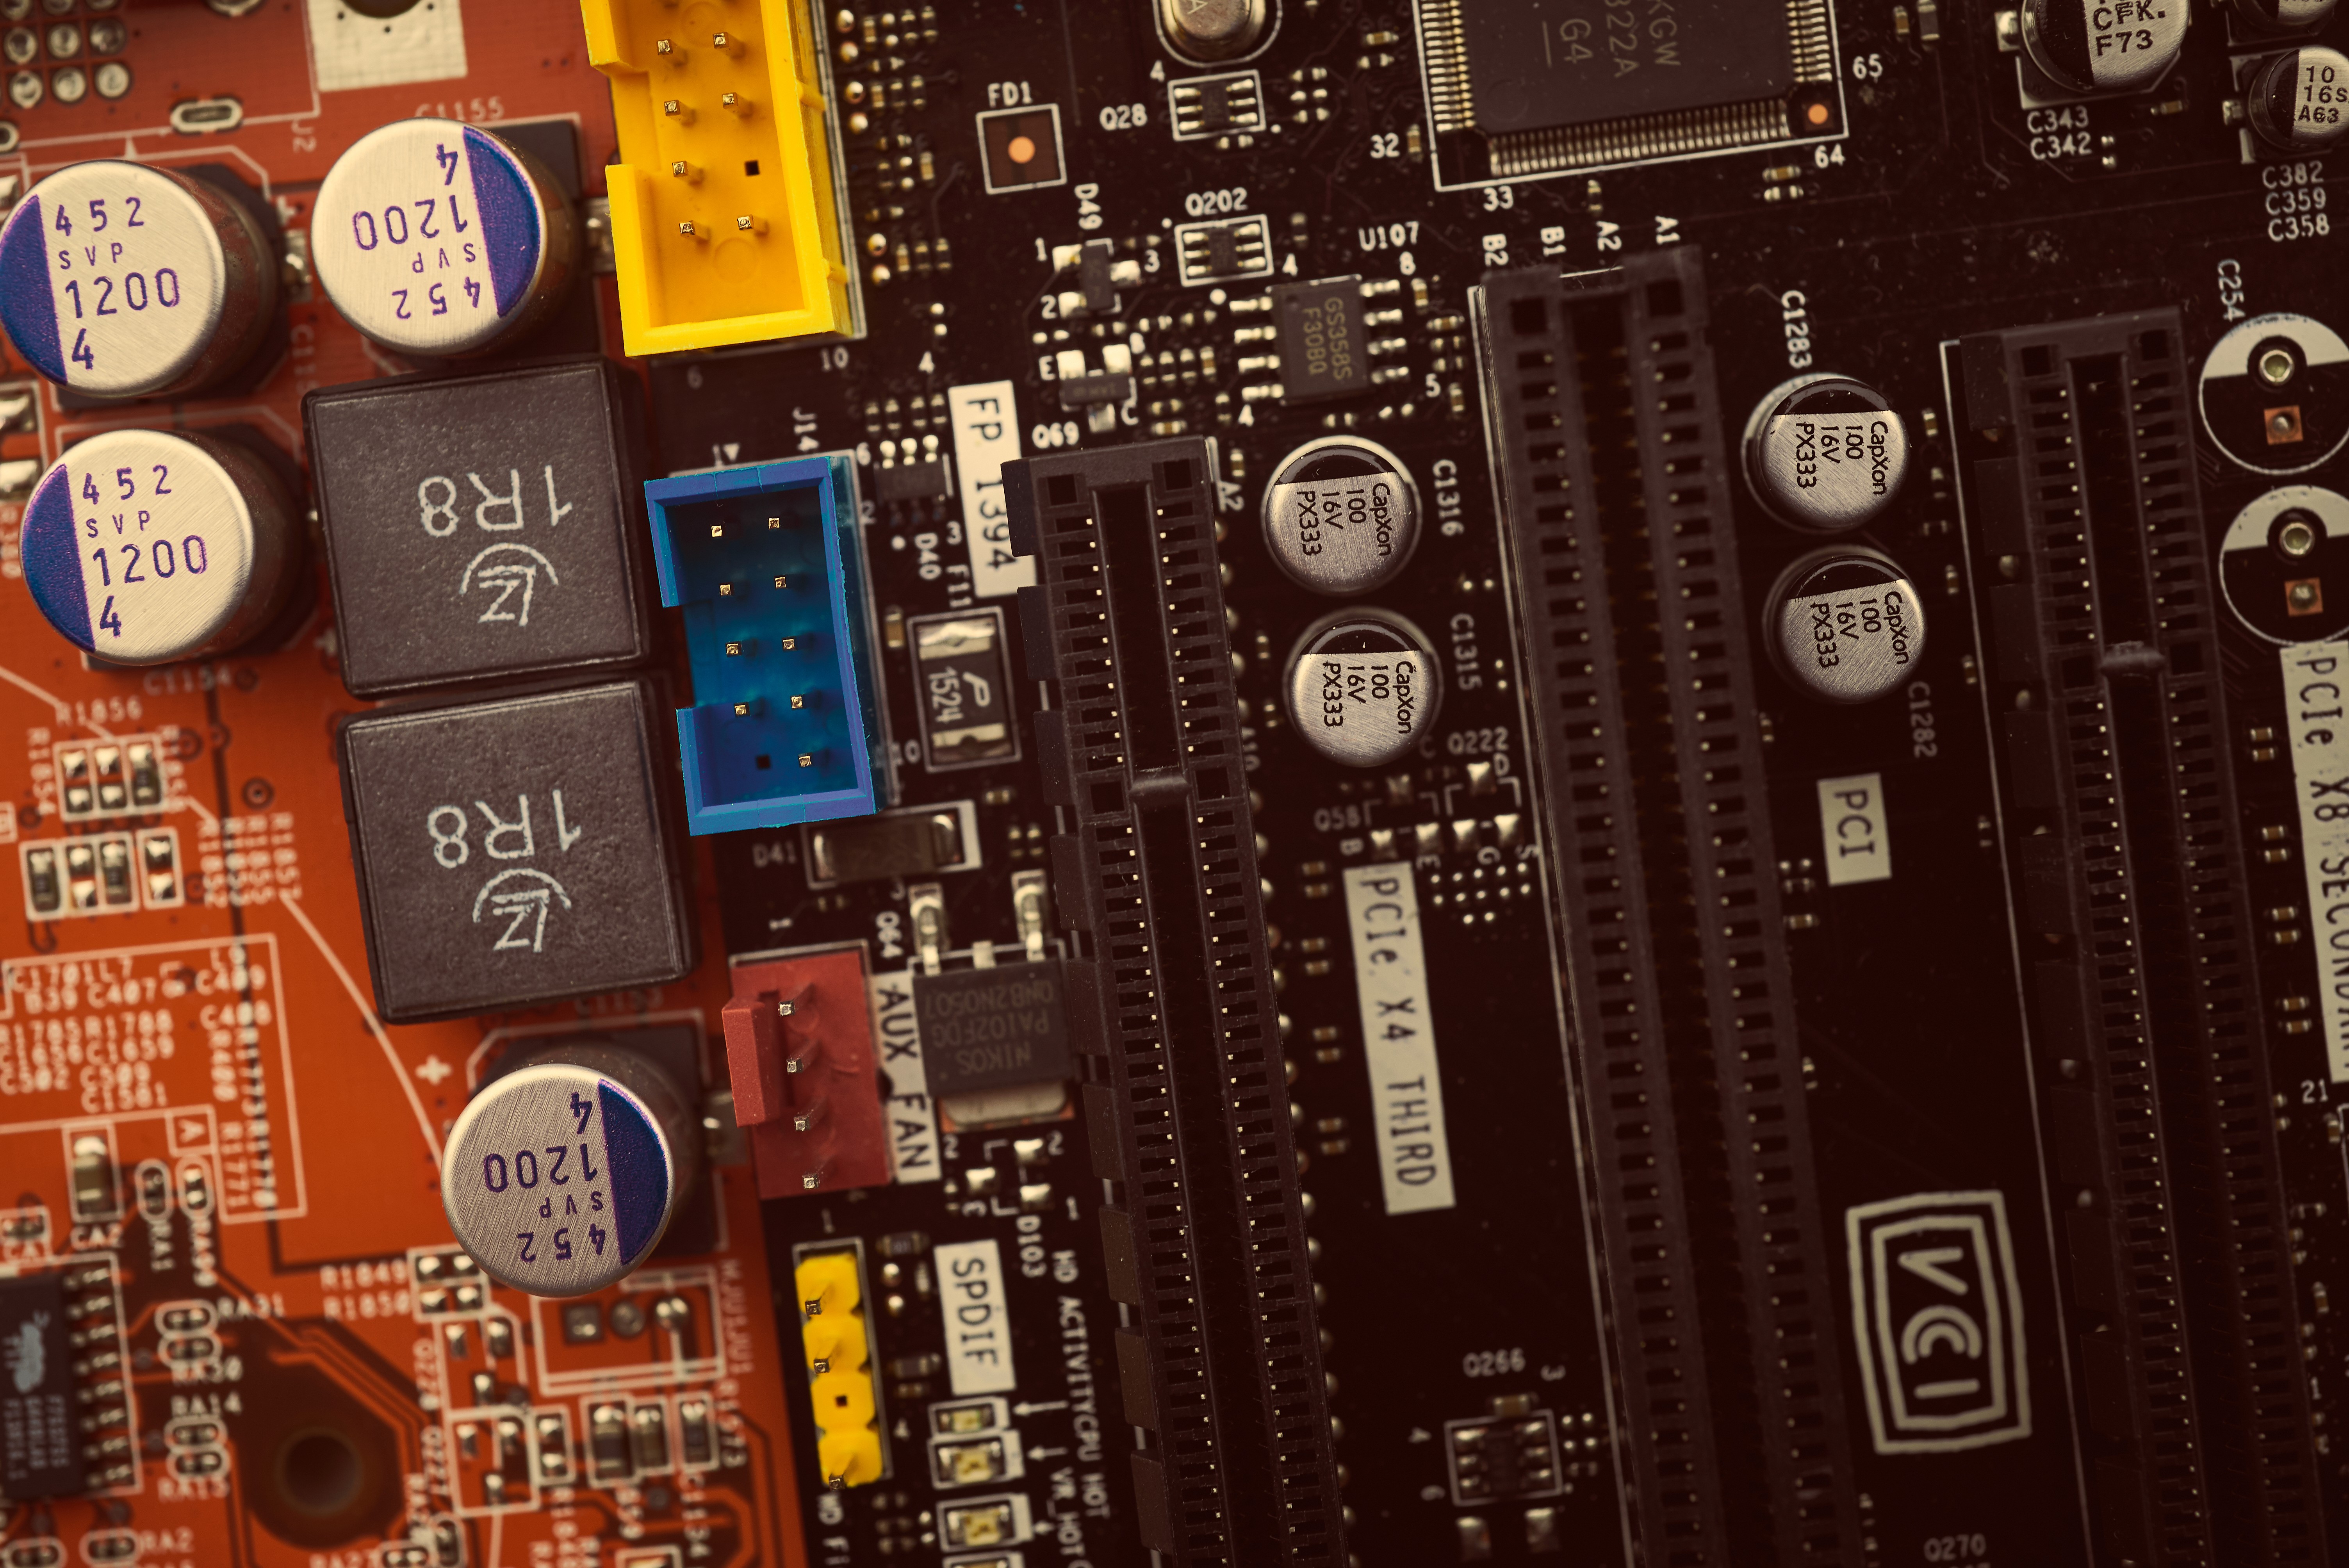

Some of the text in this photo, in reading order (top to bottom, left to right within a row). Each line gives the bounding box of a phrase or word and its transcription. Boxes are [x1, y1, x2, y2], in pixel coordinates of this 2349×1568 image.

[1560, 19, 1594, 64] G4
[2096, 30, 2153, 55] F73
[1852, 53, 1883, 79] 65
[2306, 65, 2335, 83] 10
[988, 81, 1032, 107] FD1
[2299, 104, 2339, 123] A63
[2027, 106, 2088, 134] C343
[436, 143, 458, 185] 4
[1370, 133, 1400, 159] 32
[1814, 143, 1845, 168] 64
[2030, 132, 2092, 160] C342
[2263, 160, 2324, 189] C382
[1074, 184, 1102, 230] D49
[1484, 185, 1513, 211] 33
[2265, 187, 2326, 215] C359
[352, 195, 468, 250] 1200
[1541, 226, 1566, 256] B1
[1596, 221, 1622, 251] A2
[1655, 216, 1680, 245] A1
[2268, 213, 2330, 242] C358
[1035, 238, 1047, 261] 1
[1144, 249, 1160, 272] 3
[1399, 251, 1416, 275] 8
[1483, 234, 1509, 267] B2
[65, 268, 180, 319] 1200
[1041, 295, 1056, 319] 2
[2217, 259, 2245, 321] C254
[72, 328, 94, 370] 4
[1325, 297, 1353, 381] GS358S
[1781, 290, 1812, 369] C1283
[819, 345, 849, 372] 10
[1426, 373, 1440, 397] 5
[793, 406, 819, 451] J14
[1821, 426, 1840, 463] 16V
[1845, 424, 1864, 460] 100
[1796, 422, 1816, 489] PX333
[1866, 421, 1889, 495] CapXon
[418, 465, 572, 537] 1R8
[966, 397, 1017, 571] FP 1394
[1432, 459, 1464, 536] C1316
[1296, 490, 1322, 556] PX333
[1322, 492, 1344, 529] 16V
[1346, 489, 1366, 523] 100
[1371, 482, 1391, 556] CapXon
[93, 535, 207, 586] 1200
[99, 595, 121, 638] 4
[1810, 602, 1839, 668] PX333
[1835, 602, 1859, 640] 16V
[1859, 598, 1881, 633] 100
[1884, 591, 1909, 665] CapXon
[1450, 613, 1483, 690] C1315
[1323, 662, 1344, 728] PX333
[1347, 665, 1366, 704] 16V
[1371, 665, 1390, 700] 100
[1393, 660, 1414, 734] CapXon
[2296, 657, 2344, 745] PCIe
[1908, 681, 1938, 758] C1282
[2310, 777, 2349, 822] X8
[428, 789, 582, 868] 1R8
[1834, 789, 1875, 858] PCI
[1360, 877, 1436, 1187] PCIe X4 THIRD
[877, 984, 931, 1169] AUX FAN
[570, 1093, 592, 1135] 4
[483, 1143, 598, 1193] 1200
[1017, 1214, 1047, 1278] D103
[951, 1257, 998, 1367] SPDIF
[1082, 1473, 1110, 1519] HOT
